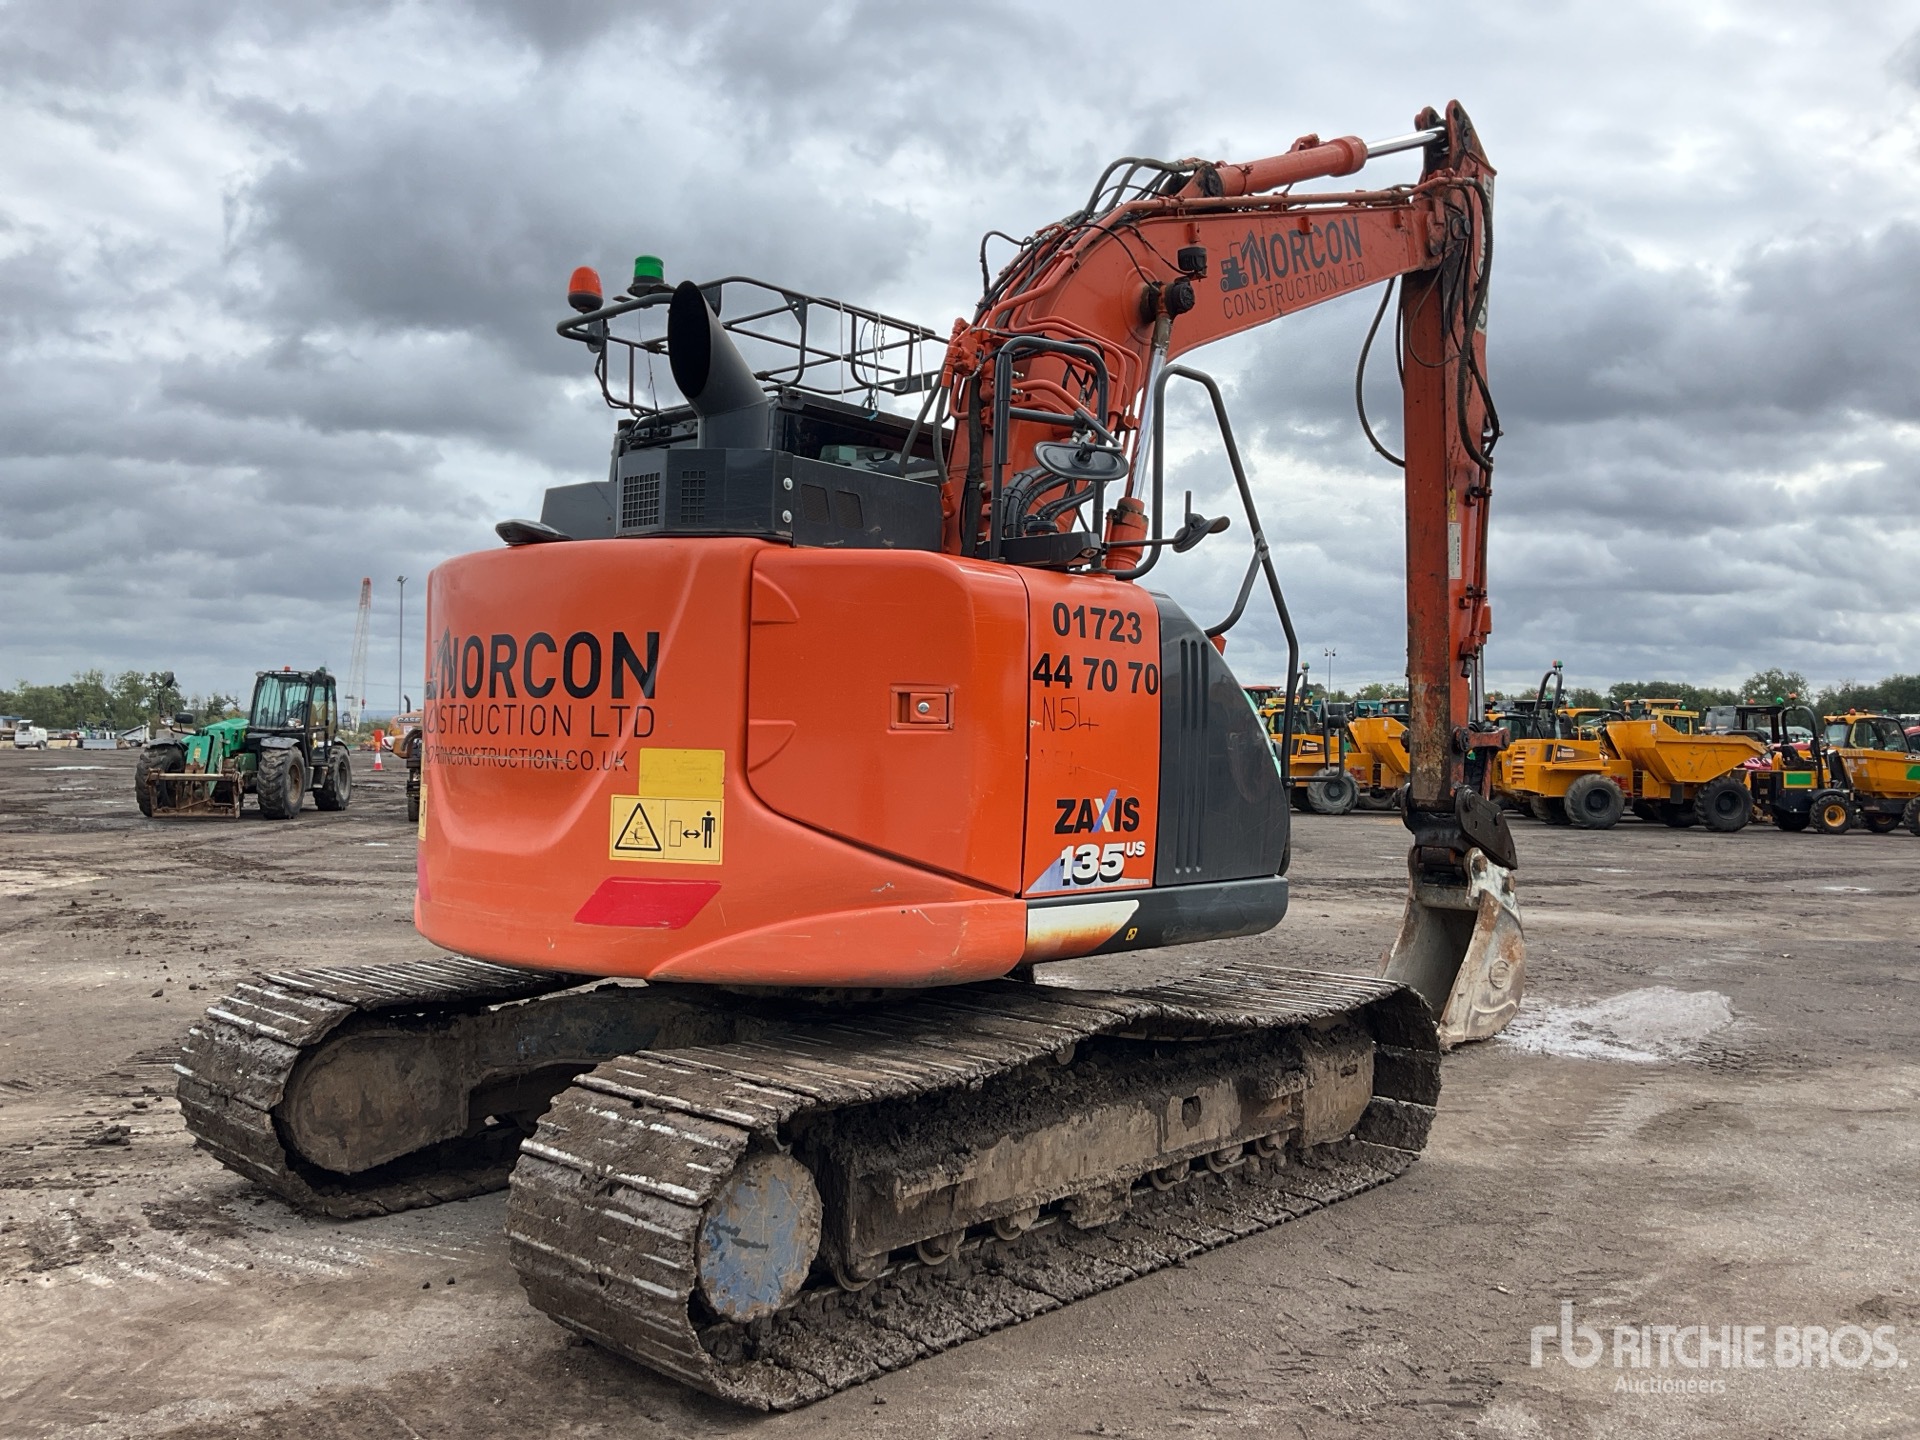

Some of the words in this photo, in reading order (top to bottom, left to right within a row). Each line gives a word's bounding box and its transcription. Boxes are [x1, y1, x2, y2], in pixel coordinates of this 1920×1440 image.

[1249, 216, 1362, 285] NORCON
[1223, 270, 1338, 320] CONSTRUCTION
[1342, 261, 1366, 287] LTD
[1053, 602, 1142, 645] 01723
[440, 629, 660, 700] NORCON
[1033, 652, 1073, 689] 44
[1083, 656, 1118, 693] 70
[1128, 661, 1159, 695] 70
[590, 704, 656, 739] LTD
[1054, 789, 1141, 835] ZAXIS
[1060, 843, 1125, 887] 135
[1125, 840, 1146, 858] US
